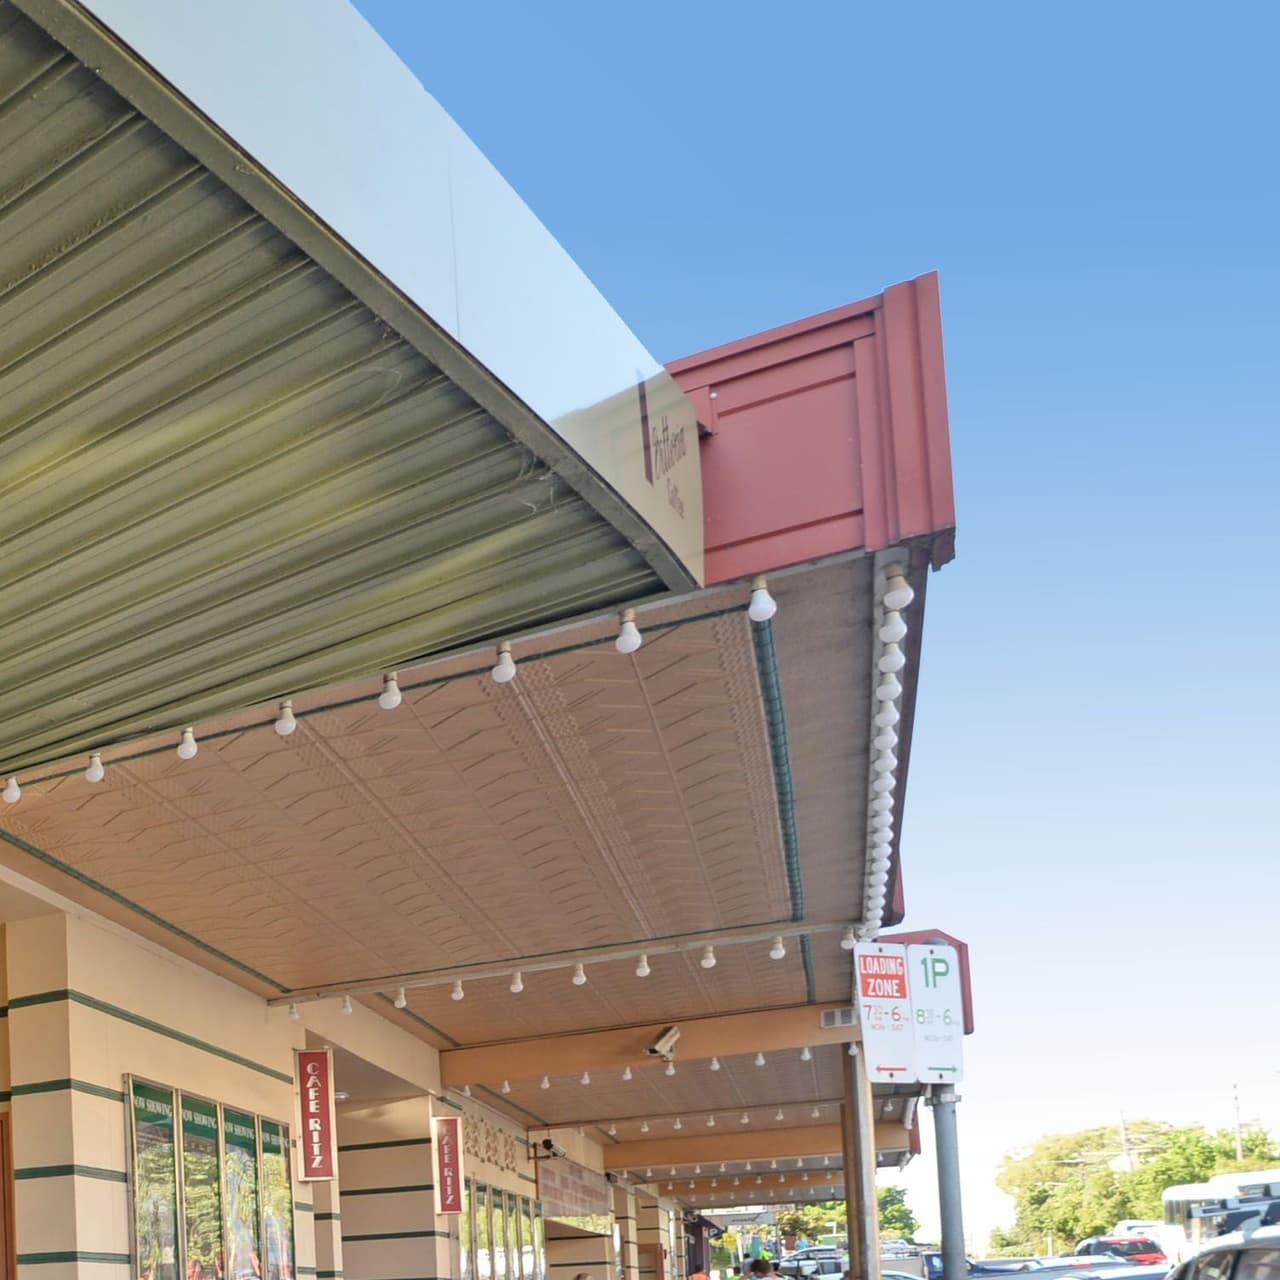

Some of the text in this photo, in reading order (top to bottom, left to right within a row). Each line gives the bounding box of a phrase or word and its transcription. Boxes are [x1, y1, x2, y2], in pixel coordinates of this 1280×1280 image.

[860, 957, 903, 975] LOADING
[920, 957, 950, 988] 1P
[867, 979, 901, 996] ZONE
[305, 1062, 324, 1169] CAFE RITZ
